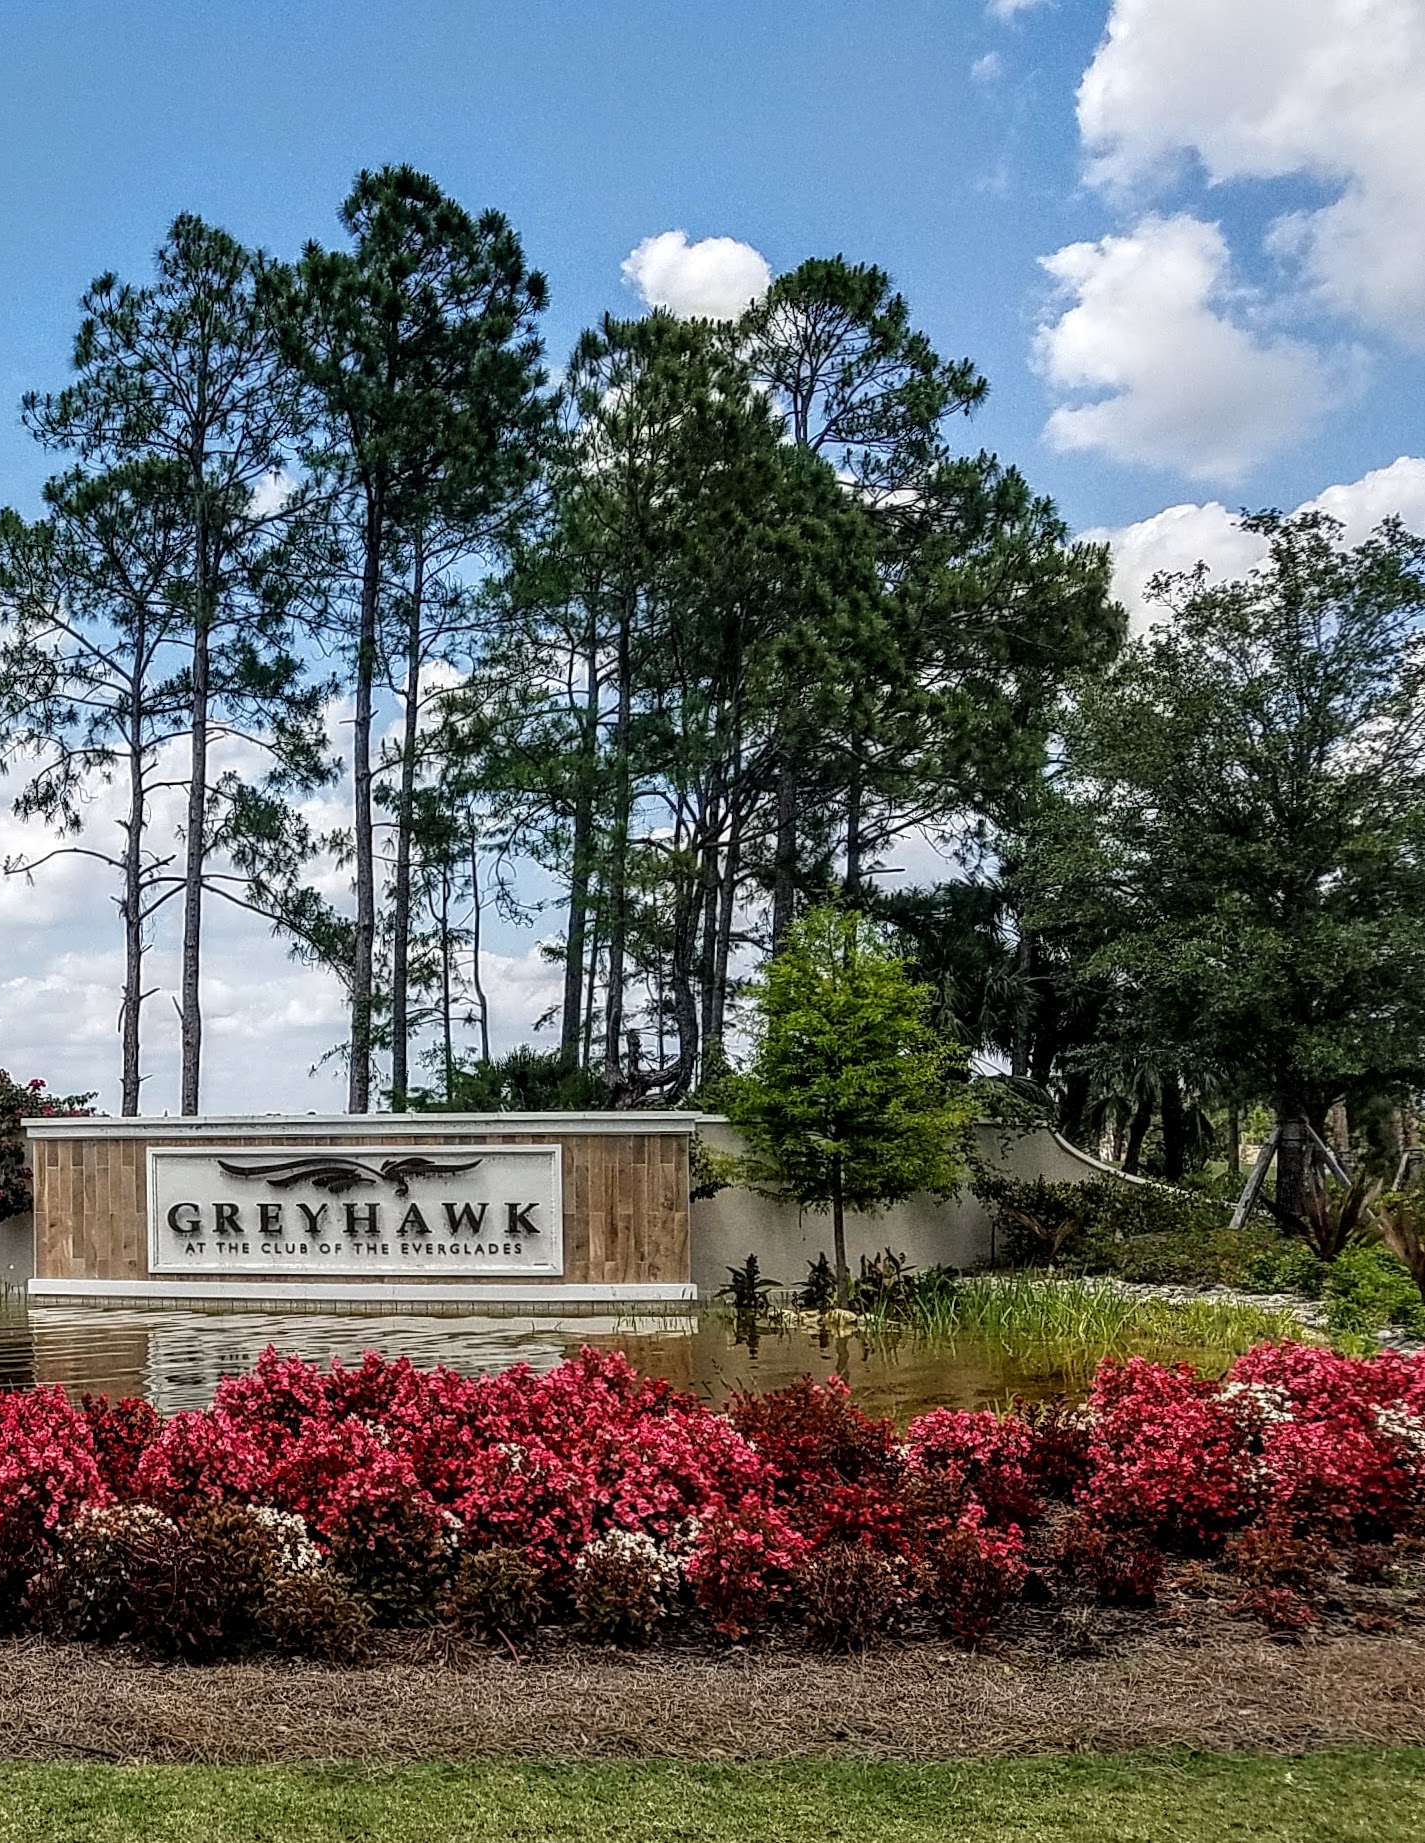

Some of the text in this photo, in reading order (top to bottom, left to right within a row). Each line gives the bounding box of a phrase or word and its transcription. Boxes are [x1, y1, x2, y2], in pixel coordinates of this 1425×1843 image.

[167, 1202, 542, 1235] GREYHAWK
[185, 1241, 523, 1256] AT THE CLUB OF THE EVERGLADES
